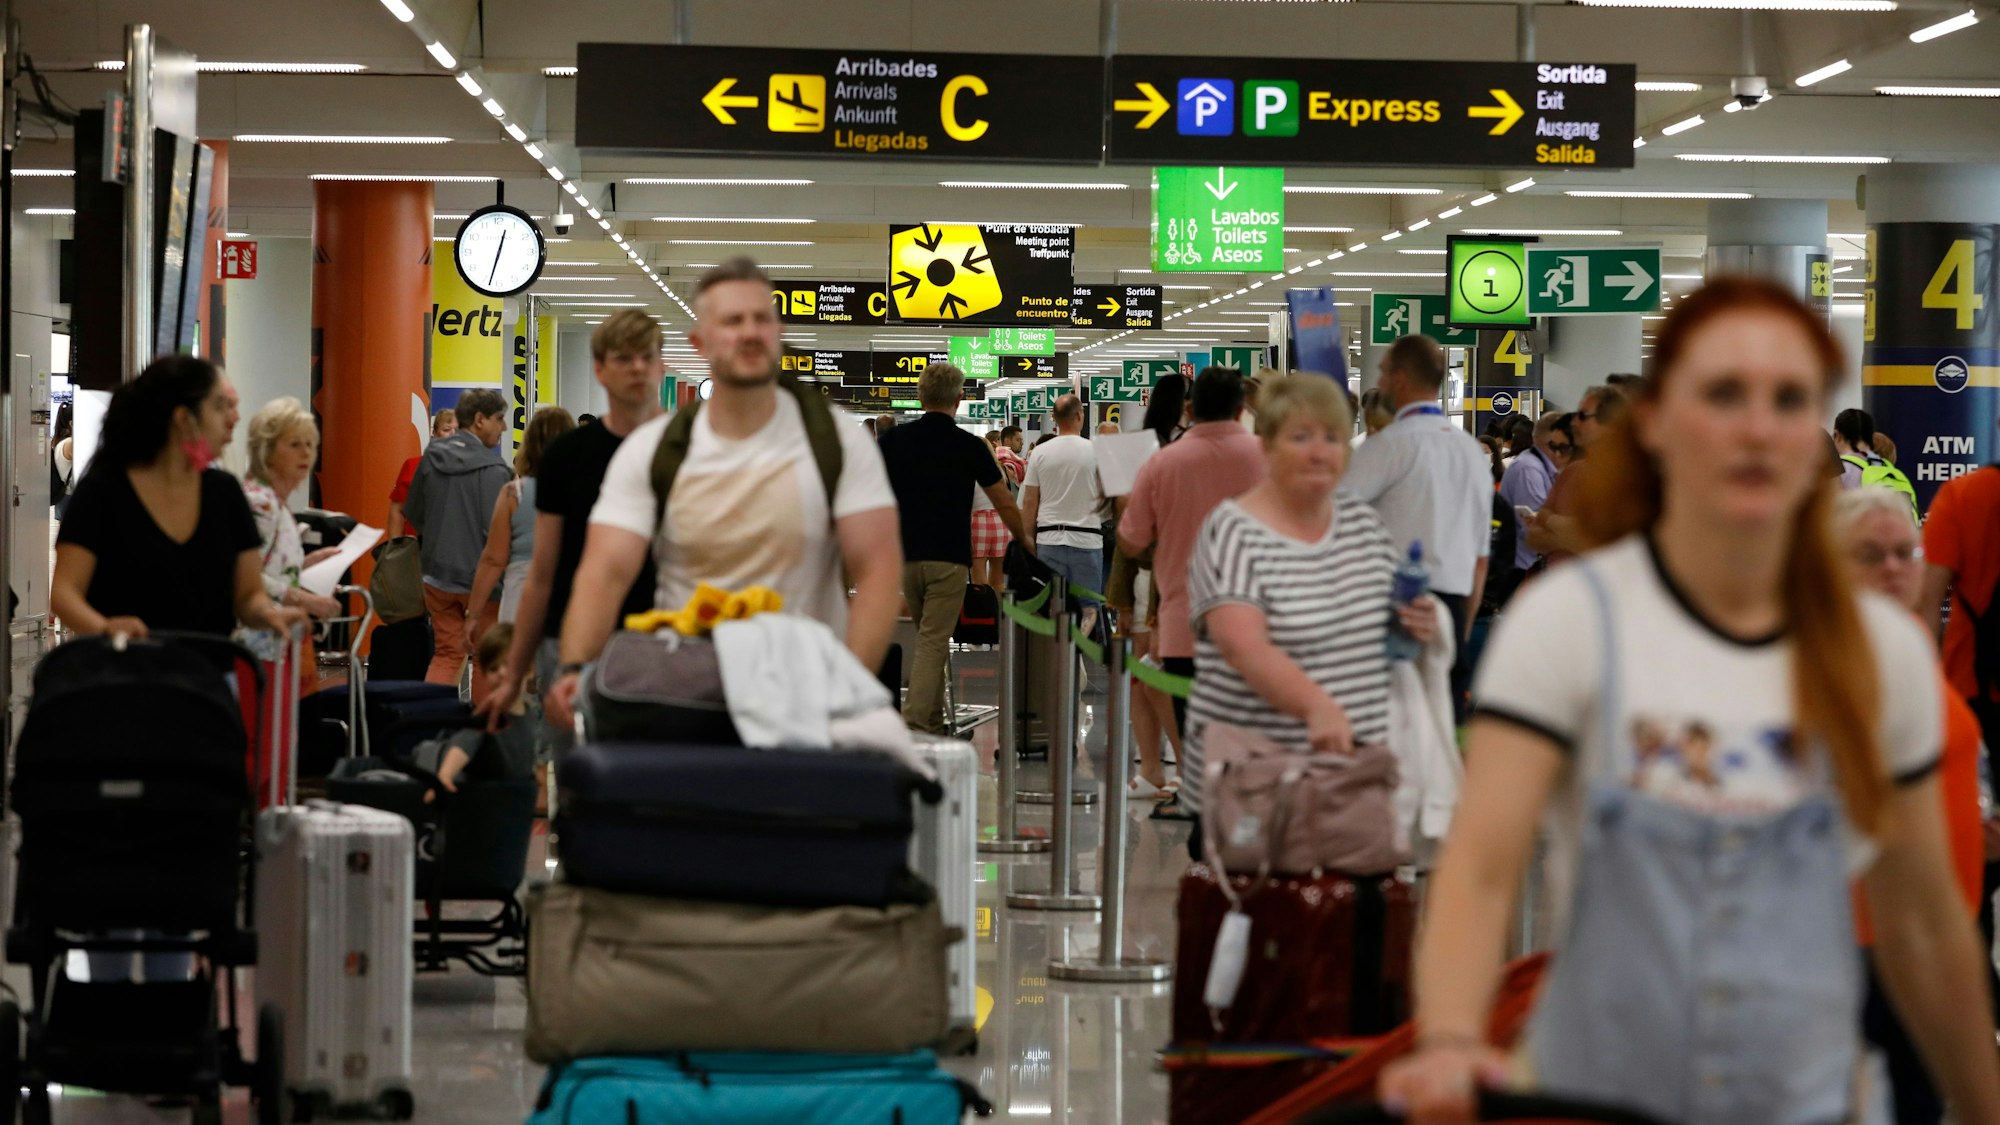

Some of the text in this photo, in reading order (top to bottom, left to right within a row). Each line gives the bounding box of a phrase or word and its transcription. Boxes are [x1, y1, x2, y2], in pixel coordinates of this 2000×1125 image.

[836, 58, 937, 78] Arribades
[1537, 64, 1606, 83] Sortida
[835, 81, 897, 100] Arrivals
[1537, 90, 1564, 110] Exit
[940, 74, 990, 142] C
[1309, 92, 1440, 127] Express
[835, 105, 896, 124] Ankunft
[1536, 117, 1599, 140] Ausgang
[835, 130, 928, 151] Llegadas
[1536, 144, 1595, 163] Salida
[1211, 208, 1279, 225] Lavabos
[986, 225, 1069, 234] Punt de trobada
[1212, 227, 1267, 243] Toilets
[1015, 236, 1069, 247] Meeting point
[1029, 248, 1069, 259] Treffpunkt
[1212, 246, 1262, 262] Aseos
[819, 285, 855, 293] Arribades
[1922, 239, 1983, 330] 4
[1127, 287, 1155, 295] Sortida
[819, 294, 843, 302] Arrivals
[1022, 296, 1068, 306] Punto de
[1126, 297, 1137, 306] Exit
[868, 292, 886, 316] C
[819, 313, 852, 322] Llegadas
[1016, 309, 1068, 318] encuentro
[1126, 308, 1152, 317] Ausgang
[1126, 317, 1151, 326] Salida
[1018, 330, 1046, 340] Toilets
[1018, 341, 1043, 350] Aseos
[970, 353, 998, 361] Lavabos
[971, 360, 992, 368] Toilets
[970, 367, 991, 375] Aseos
[1922, 436, 1975, 454] ATM
